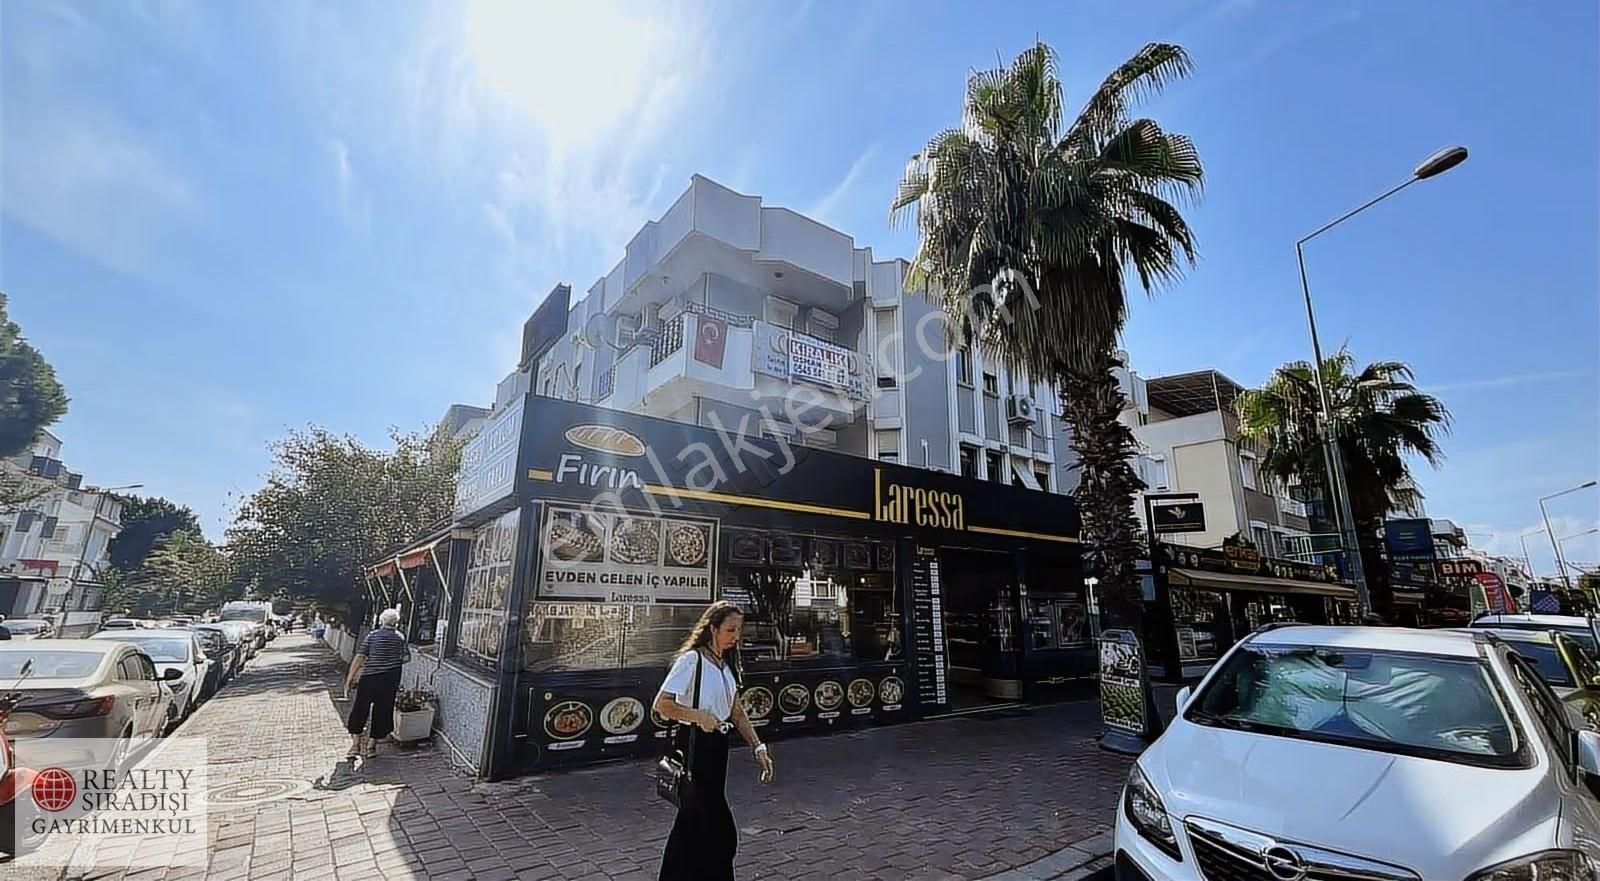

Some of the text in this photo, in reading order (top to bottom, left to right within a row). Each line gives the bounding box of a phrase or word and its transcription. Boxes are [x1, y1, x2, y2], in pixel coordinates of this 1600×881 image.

[874, 468, 965, 530] Laressa
[545, 571, 709, 589] EVDEN GELEN İÇ YAPILIR
